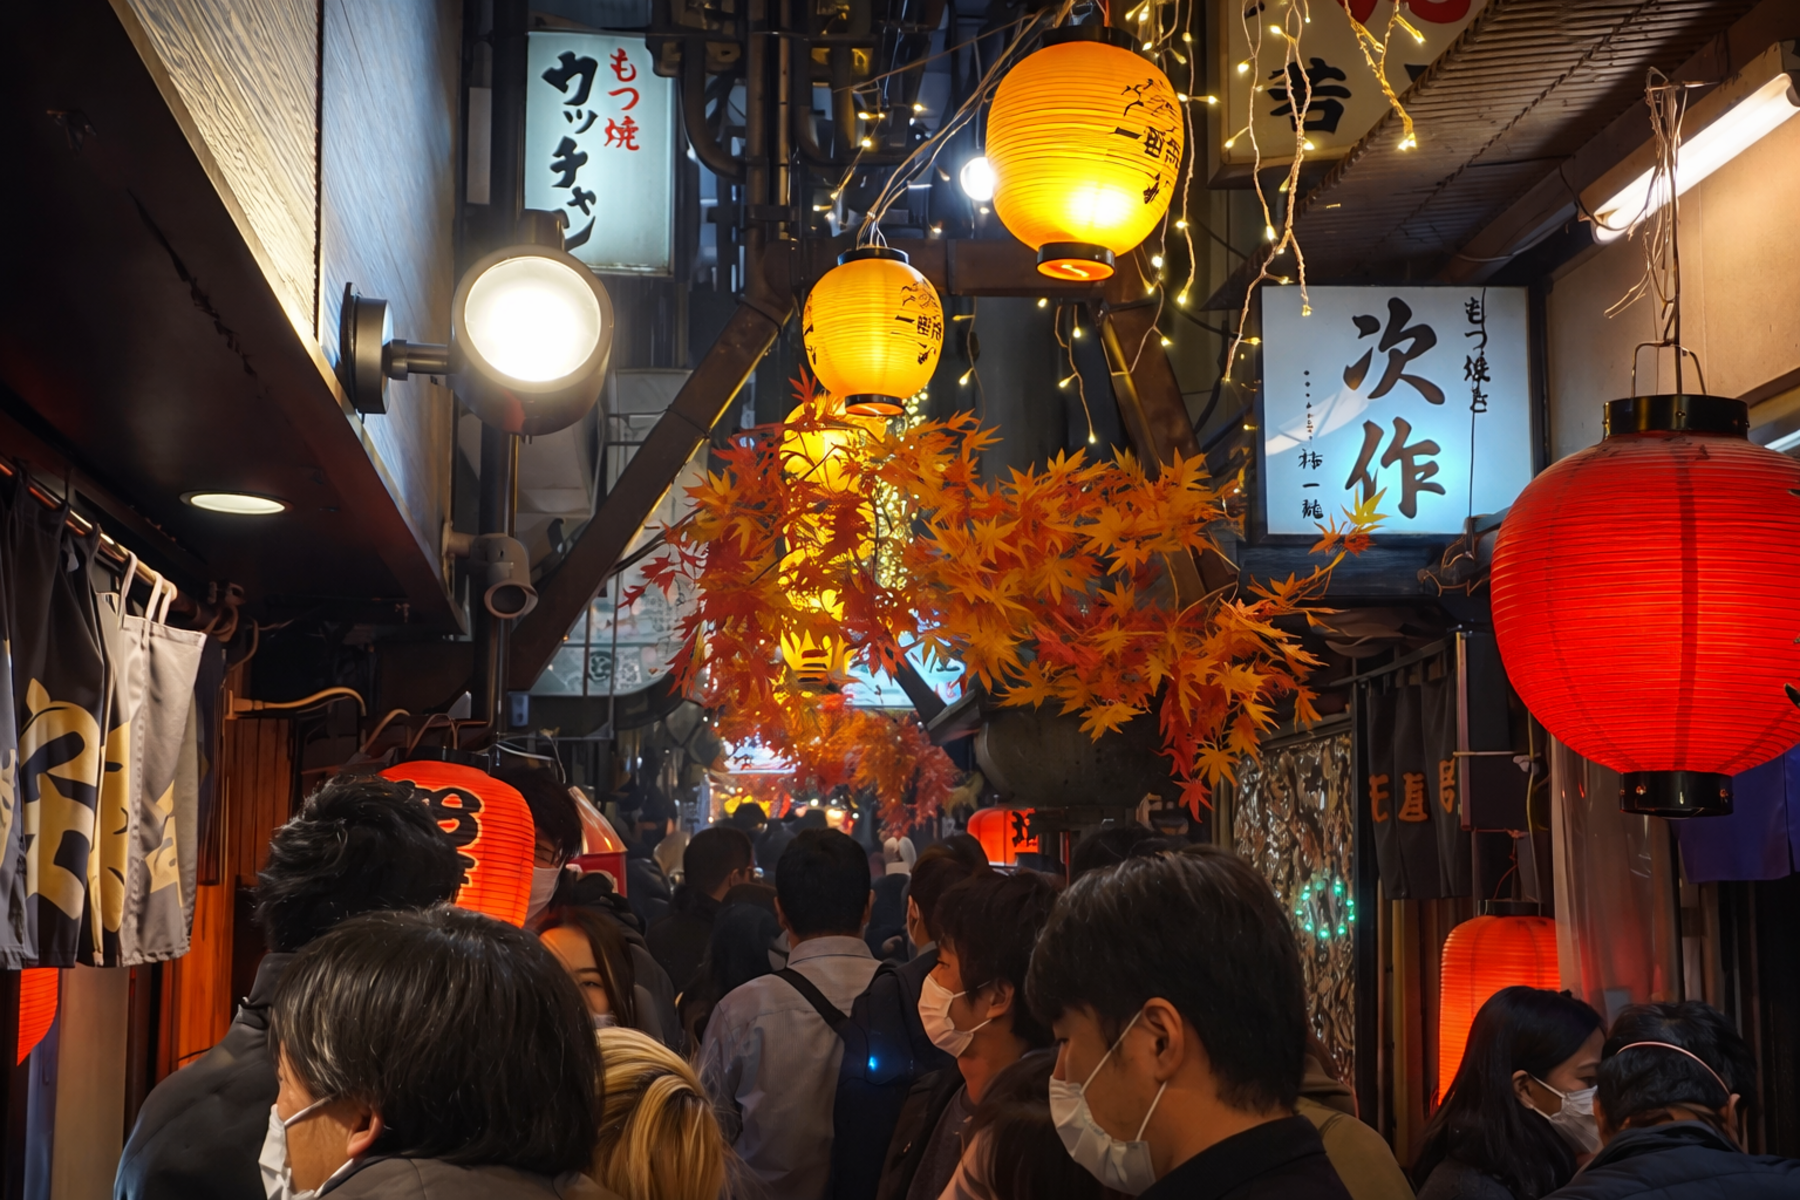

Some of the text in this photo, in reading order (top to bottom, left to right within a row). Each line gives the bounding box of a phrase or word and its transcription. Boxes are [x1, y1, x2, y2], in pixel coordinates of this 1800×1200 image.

[541, 51, 599, 251] ウッチャン
[604, 48, 640, 151] もつ焼
[1343, 297, 1446, 519] 次作
